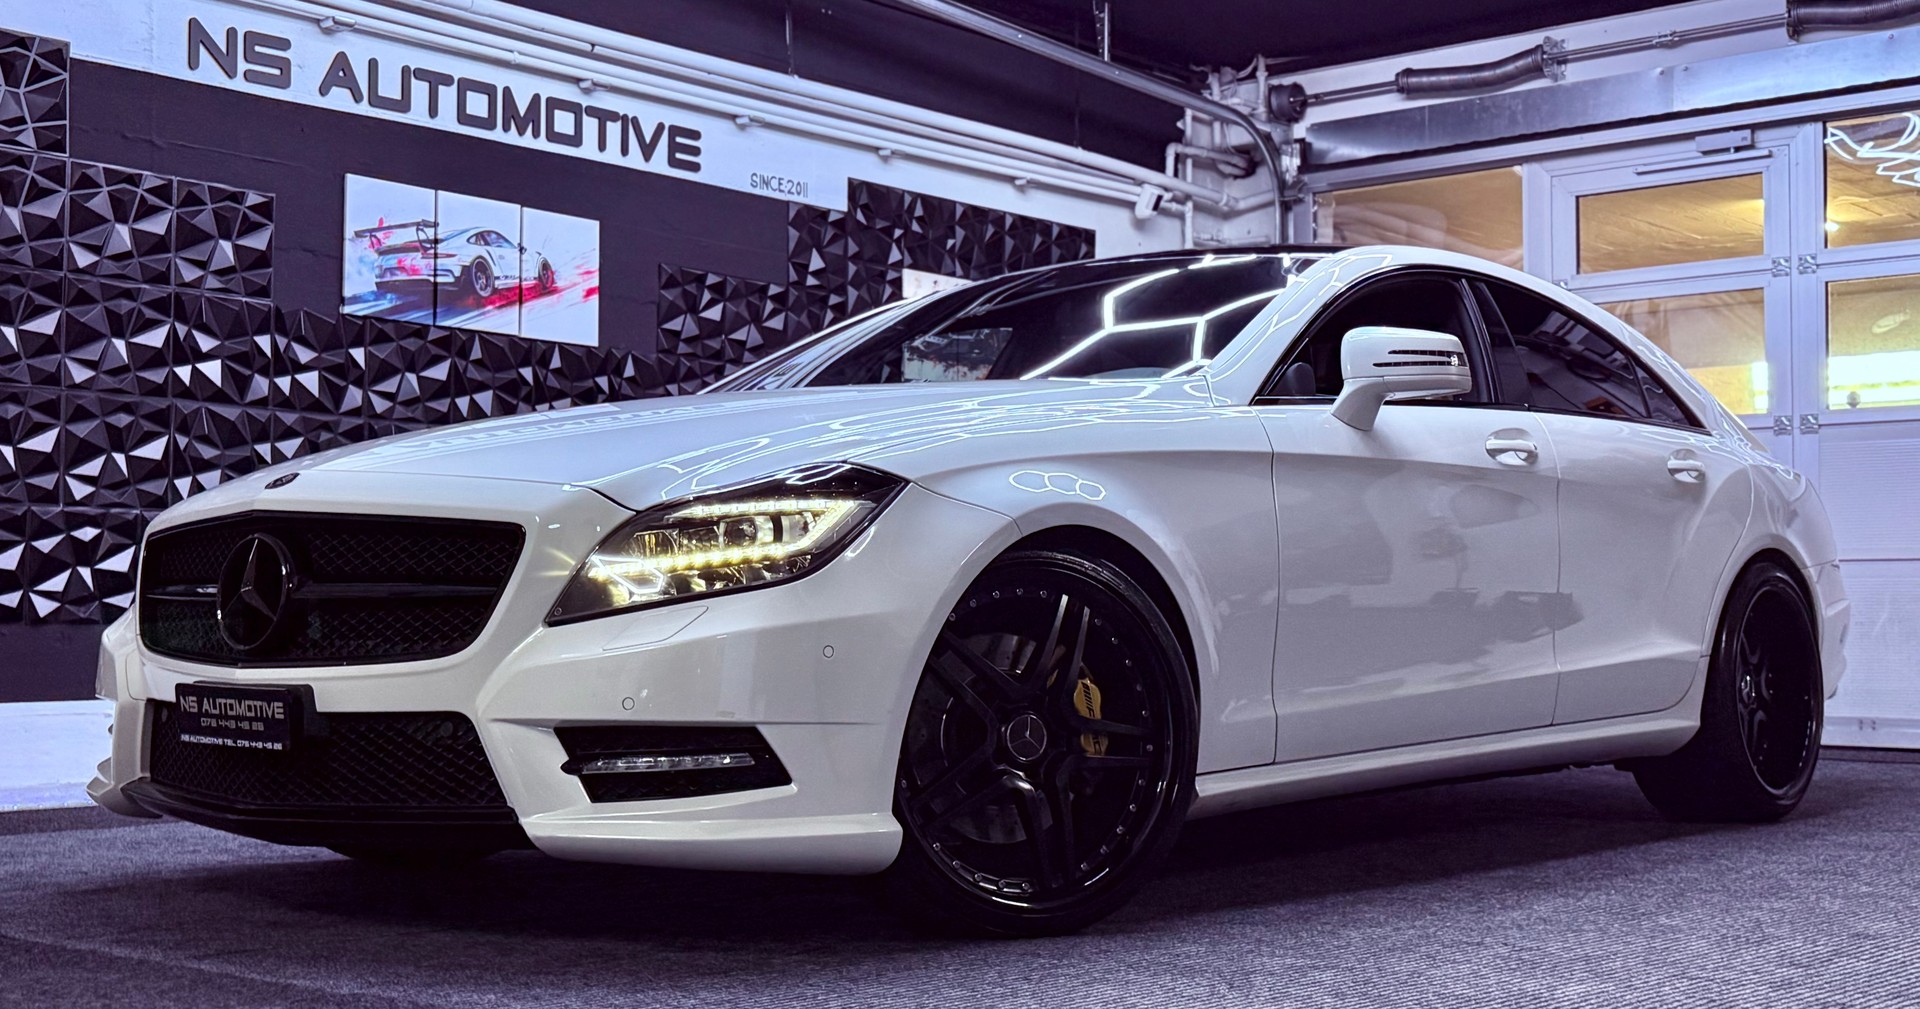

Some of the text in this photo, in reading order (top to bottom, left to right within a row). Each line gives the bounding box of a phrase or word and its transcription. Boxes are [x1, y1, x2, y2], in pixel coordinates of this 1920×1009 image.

[187, 15, 702, 173] NS AUTOMOTIVE
[180, 696, 285, 719] NS AUTOMOTIVE
